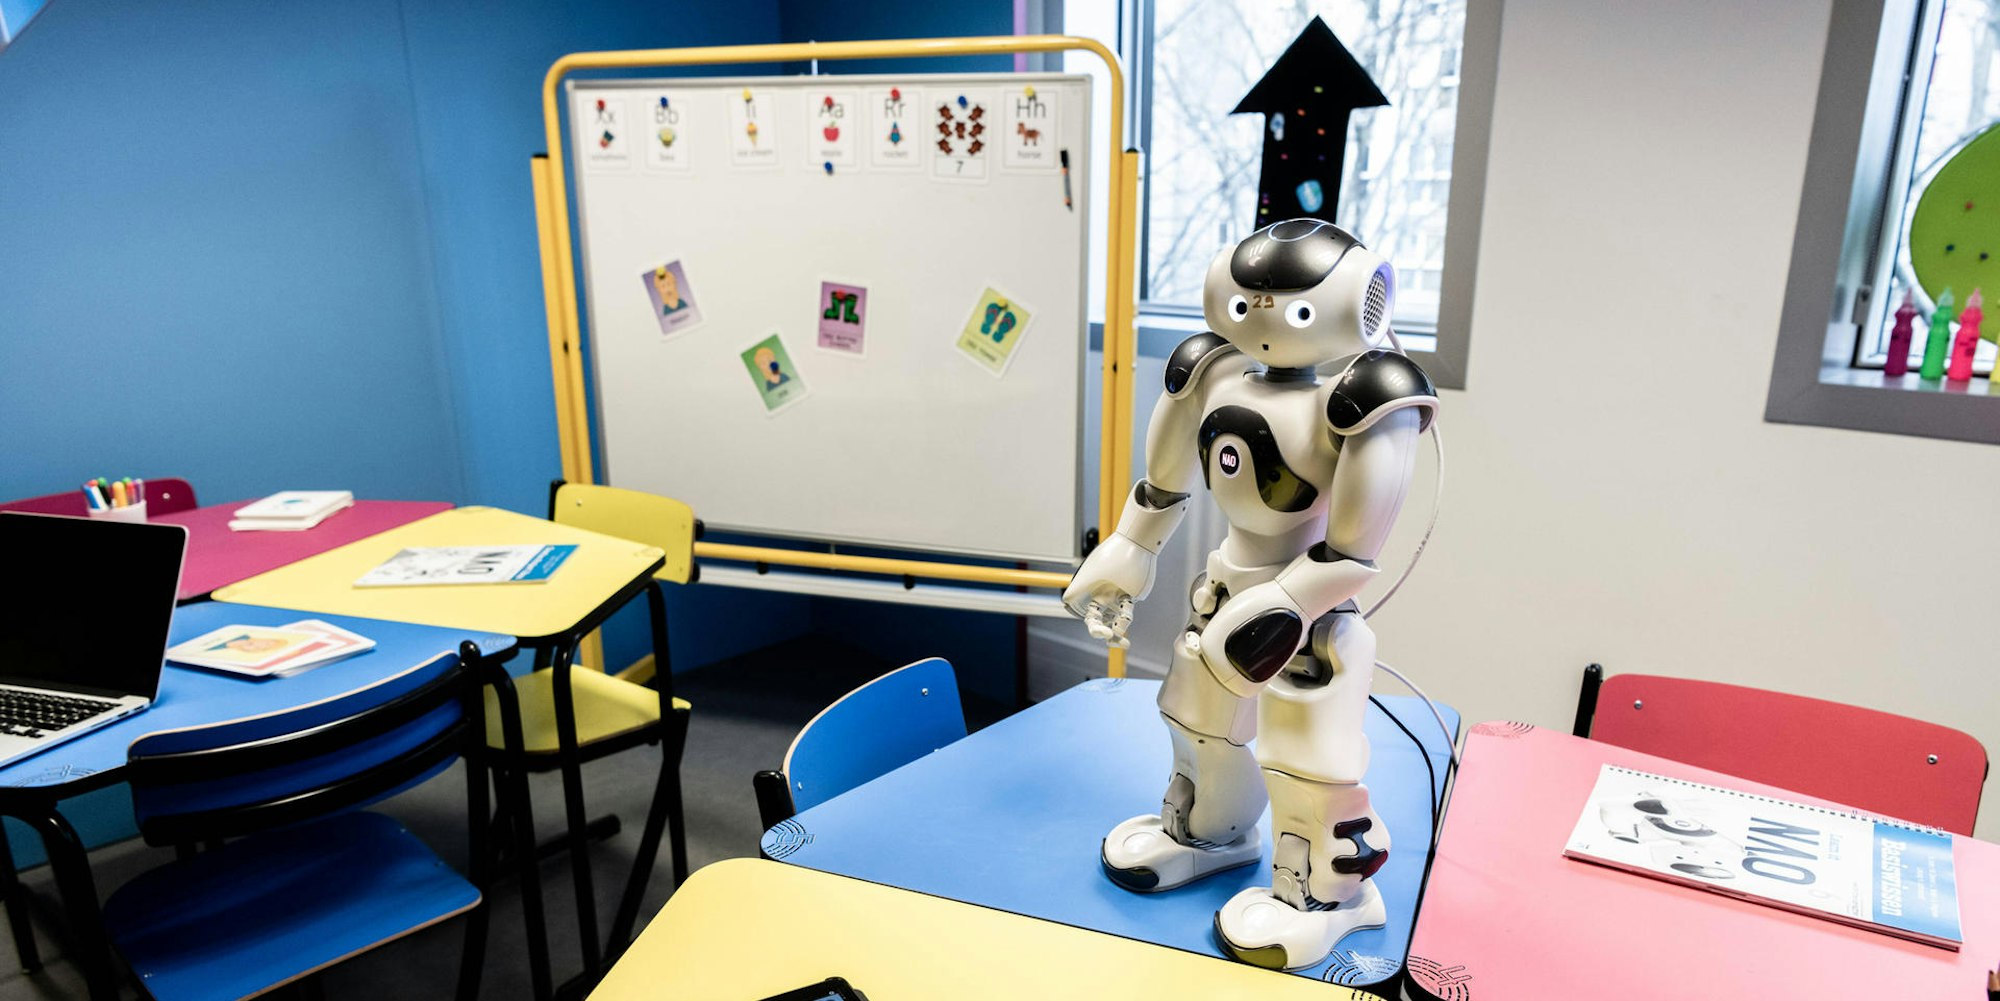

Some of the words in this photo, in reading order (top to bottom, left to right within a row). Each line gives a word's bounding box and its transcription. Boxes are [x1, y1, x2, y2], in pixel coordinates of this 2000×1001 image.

[655, 104, 679, 124] Bb
[818, 99, 845, 118] Aa
[883, 97, 906, 118] Rr
[1015, 97, 1047, 118] Hh
[956, 160, 965, 173] 7
[1252, 294, 1275, 309] 29
[1221, 452, 1237, 468] NAO
[1741, 816, 1821, 885] NAO
[1880, 837, 1909, 917] Basiswissen
